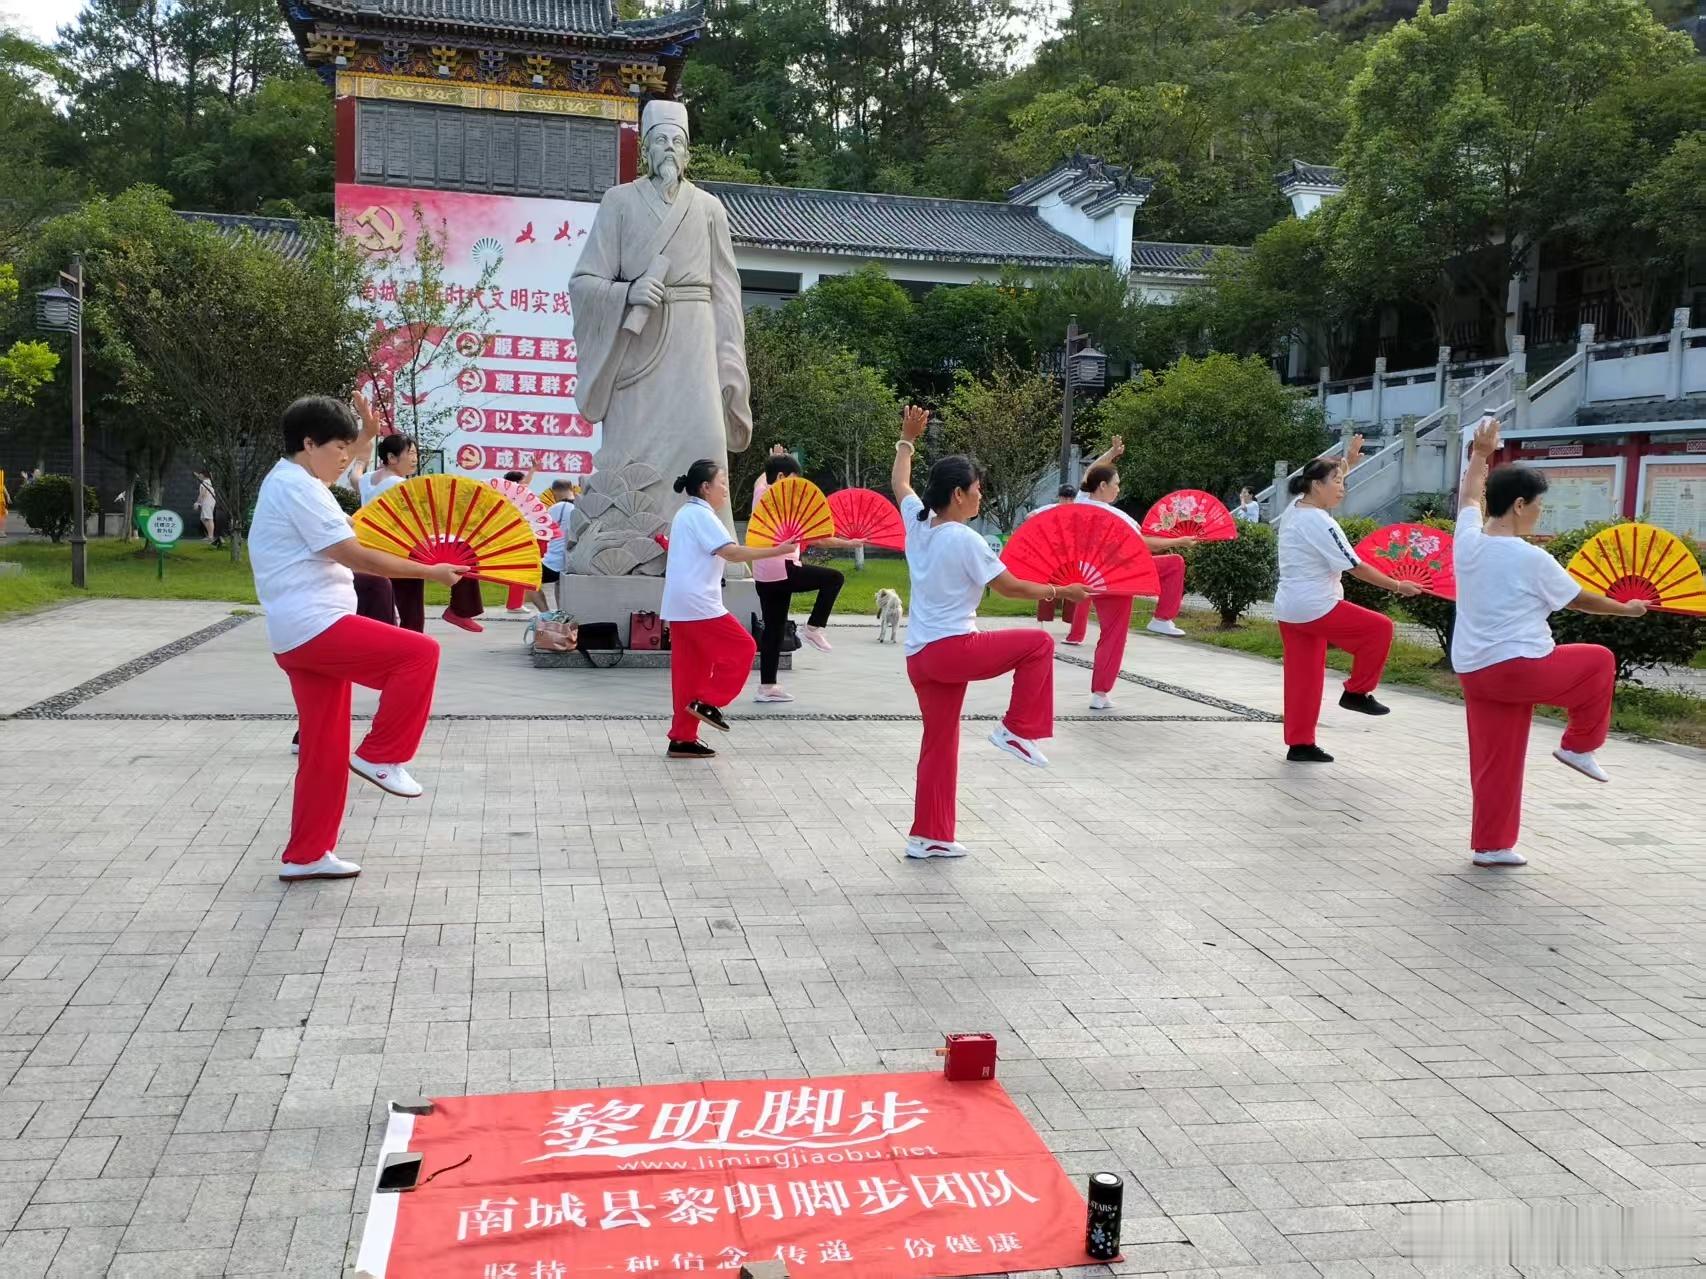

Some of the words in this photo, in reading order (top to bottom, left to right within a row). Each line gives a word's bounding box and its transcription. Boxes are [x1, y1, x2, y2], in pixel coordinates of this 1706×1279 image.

[495, 412, 582, 434] 以文化人
[495, 450, 583, 472] 成风化俗
[539, 1087, 930, 1151] 黎明脚步
[616, 1145, 939, 1170] www.limingjiaobu.net
[457, 1168, 1041, 1241] 南城县黎明脚步团队
